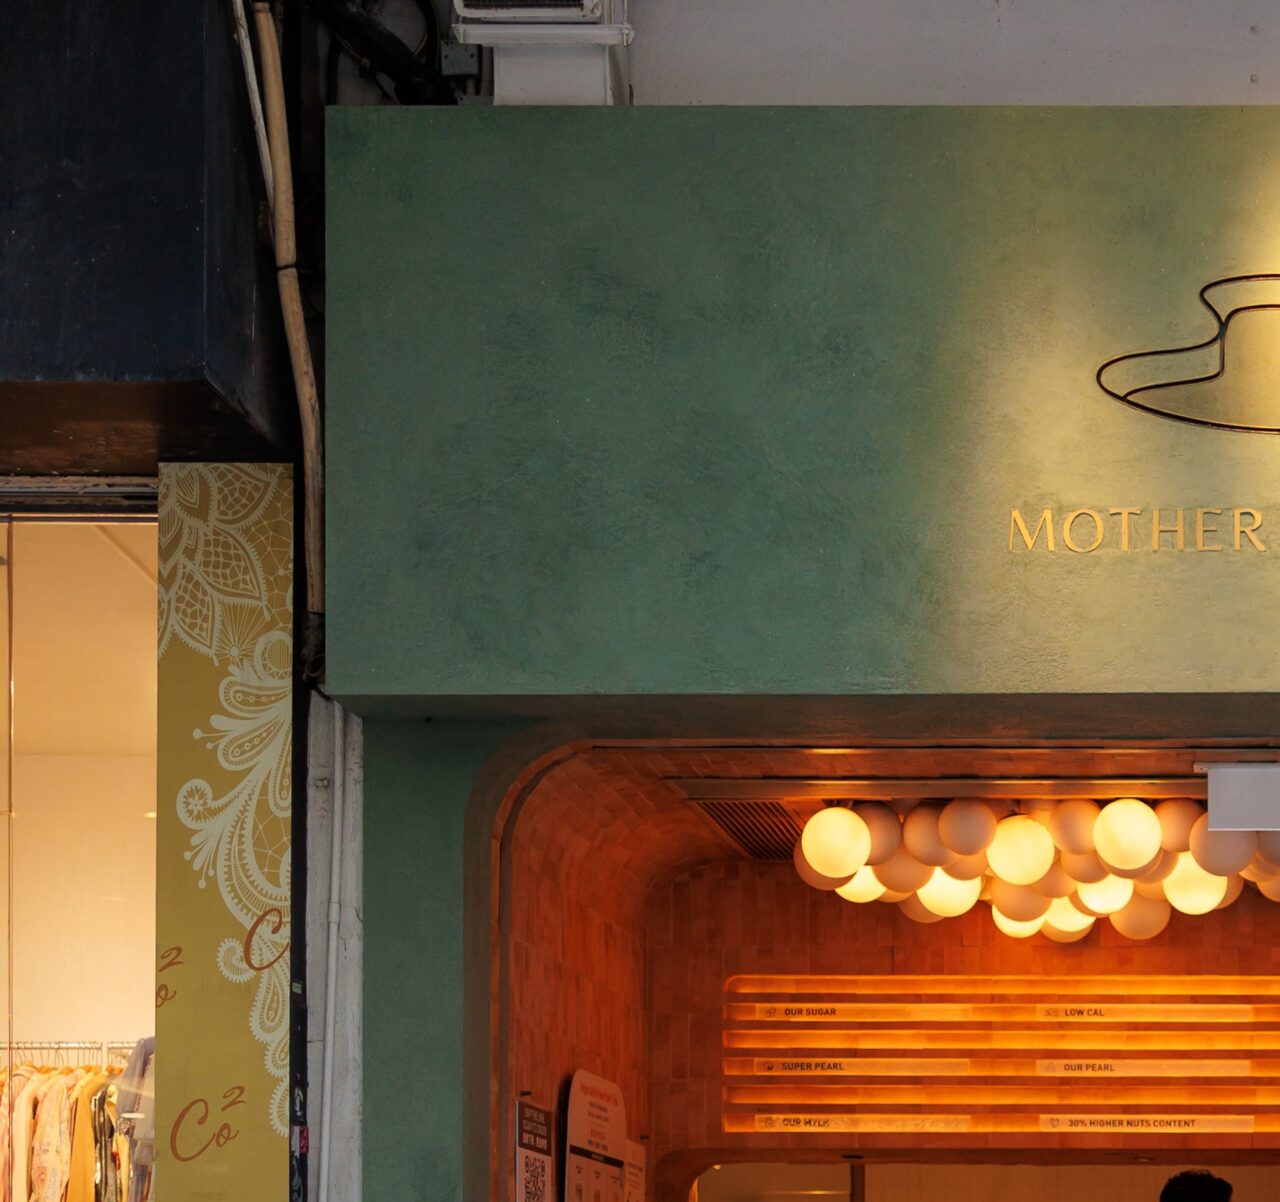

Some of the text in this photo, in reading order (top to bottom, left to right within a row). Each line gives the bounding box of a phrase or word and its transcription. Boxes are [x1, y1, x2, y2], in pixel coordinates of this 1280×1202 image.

[1008, 507, 1266, 553] MOTHER
[784, 1008, 837, 1016] OUR SUGAR
[1065, 1008, 1104, 1017] LOW CAL
[782, 1062, 844, 1071] SUPER PEARL
[1064, 1063, 1115, 1072] OUR PEARL
[782, 1118, 801, 1127] OUR
[1068, 1119, 1196, 1128] 30% HIGHER NUTS CONTENT
